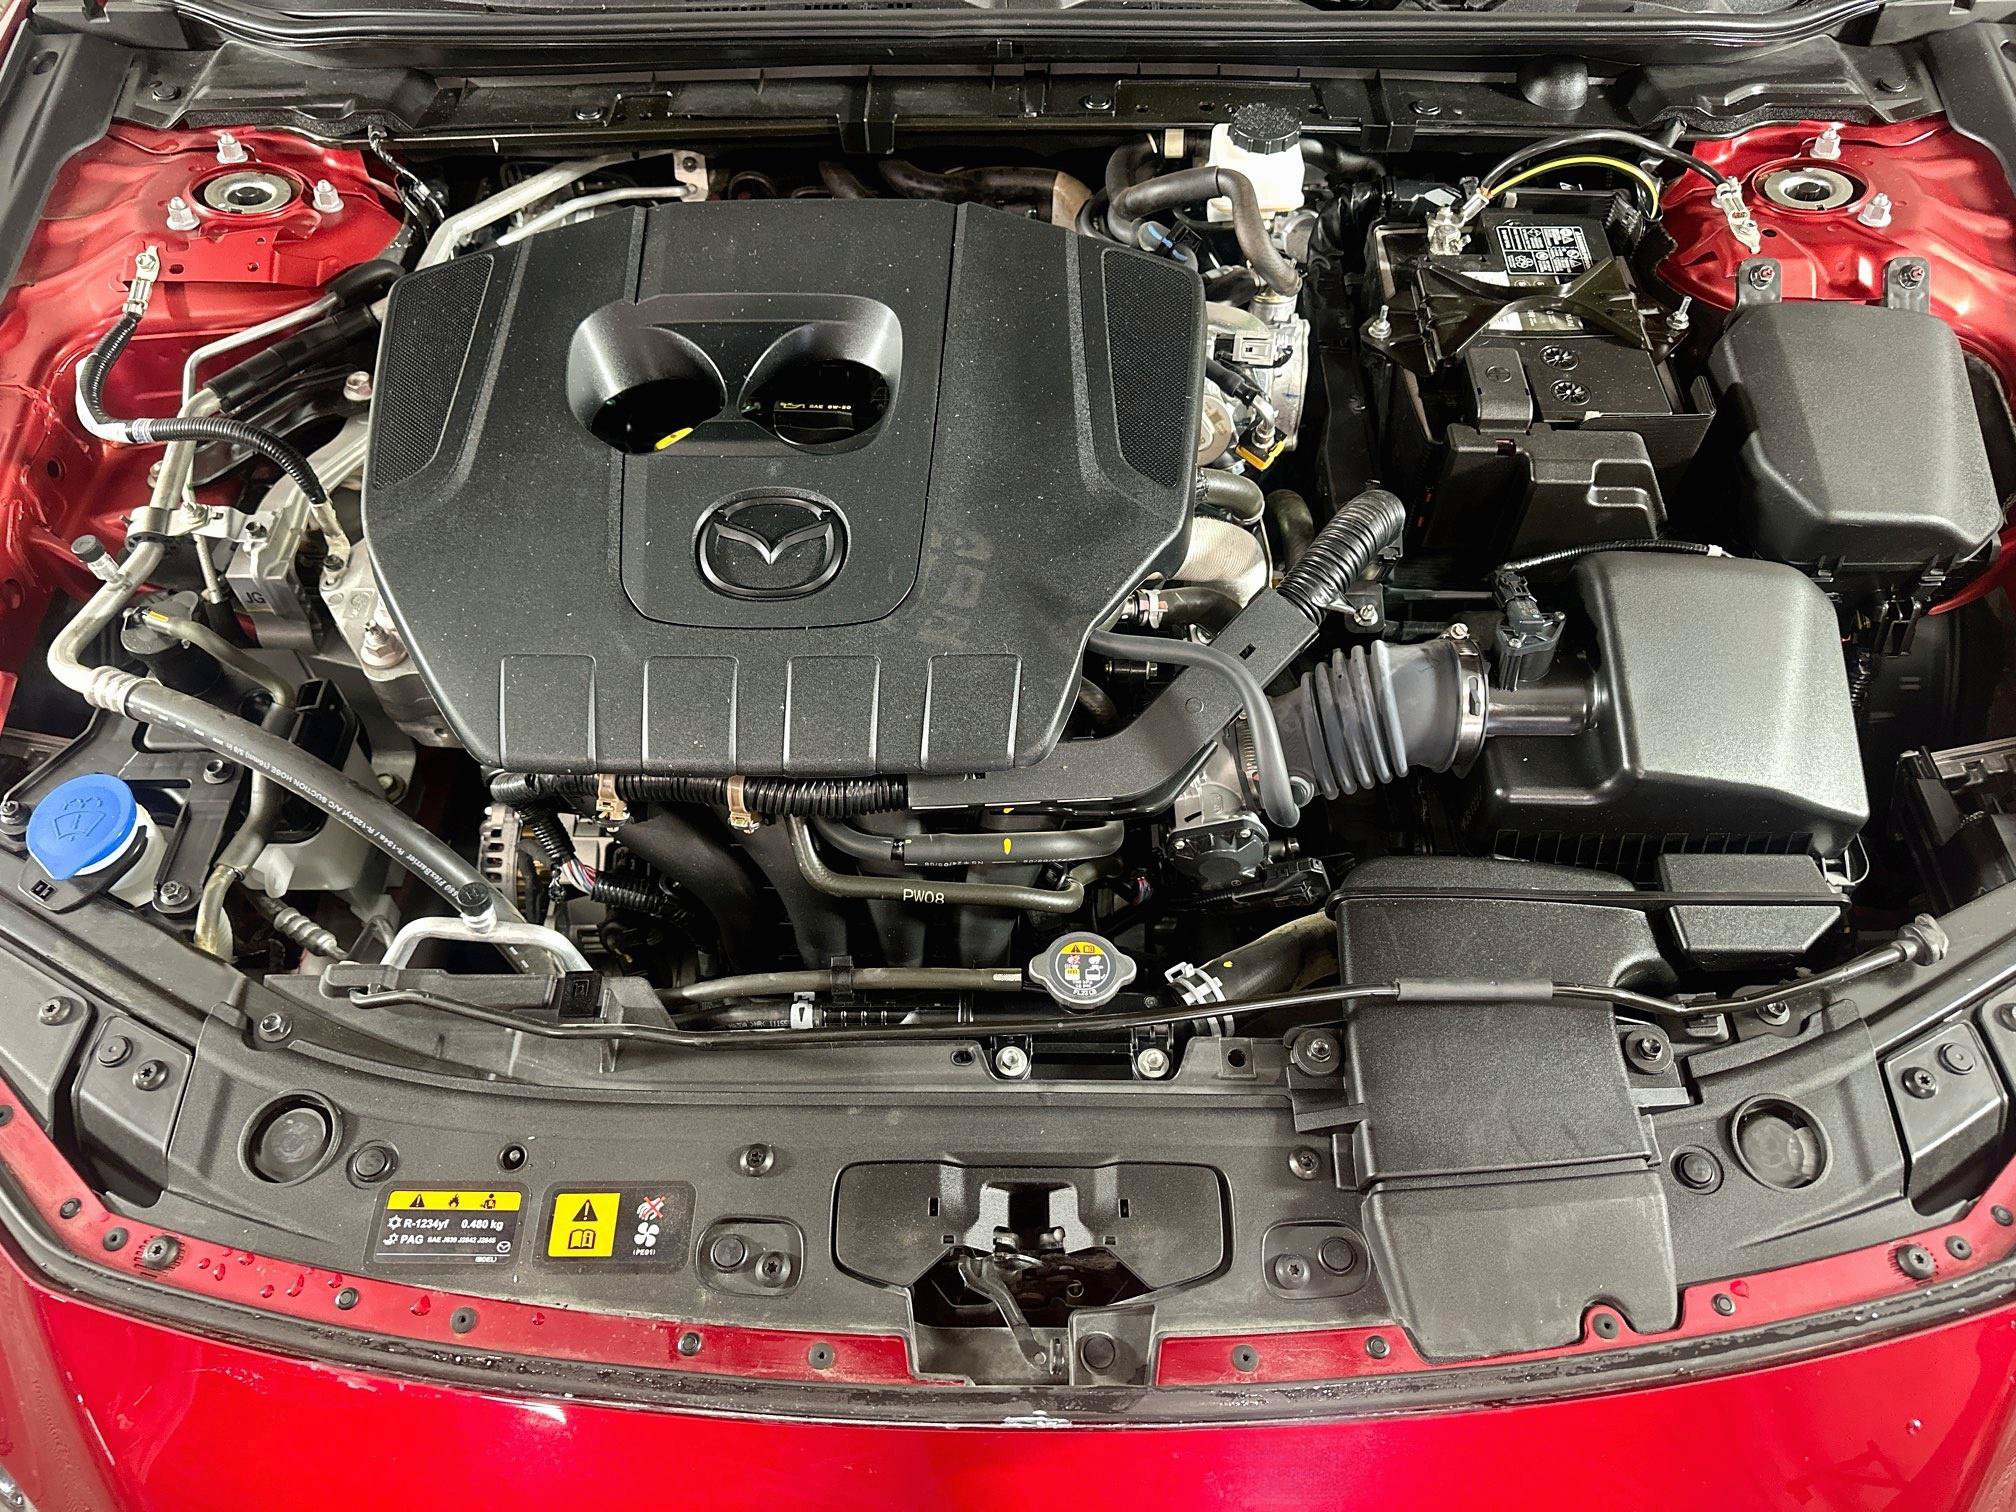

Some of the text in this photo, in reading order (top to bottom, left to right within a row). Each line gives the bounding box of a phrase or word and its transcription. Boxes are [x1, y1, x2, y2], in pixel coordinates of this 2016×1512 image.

[246, 592, 266, 604] JG
[270, 766, 294, 783] HOSE
[293, 779, 329, 803] SUCTION
[406, 853, 447, 886] FlexBarrier
[902, 888, 945, 904] PW08
[403, 1219, 504, 1232] R-1234yf 0.480 kg
[400, 1234, 424, 1245] PAG
